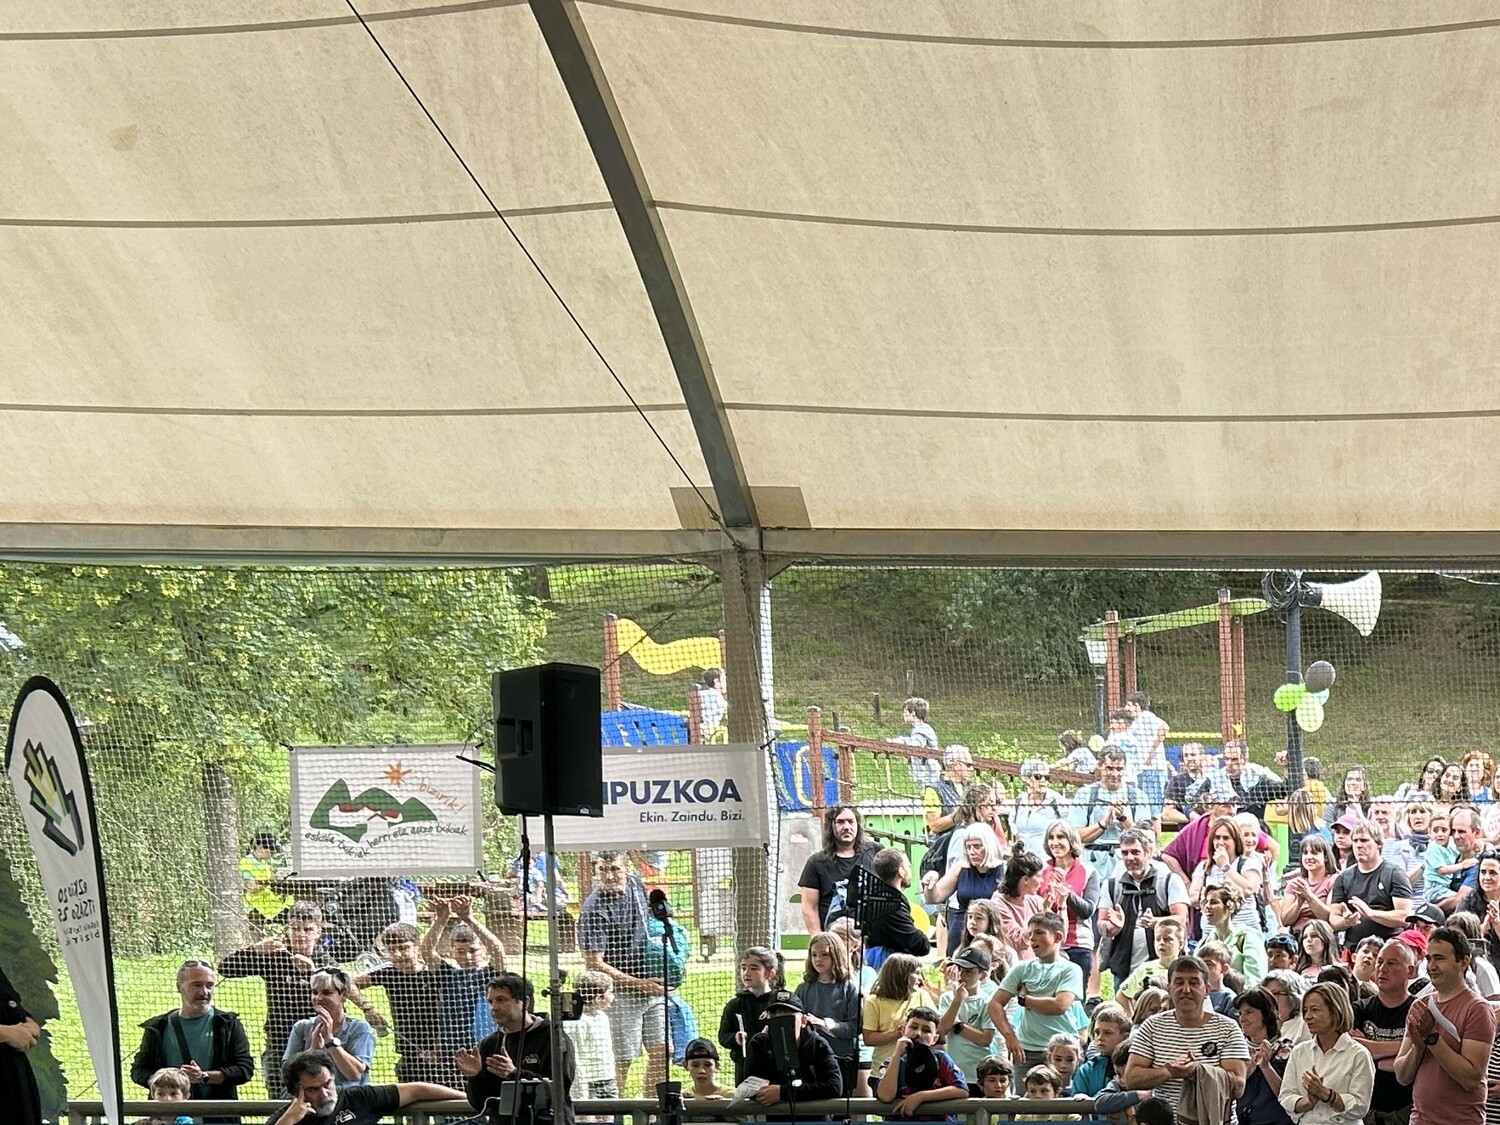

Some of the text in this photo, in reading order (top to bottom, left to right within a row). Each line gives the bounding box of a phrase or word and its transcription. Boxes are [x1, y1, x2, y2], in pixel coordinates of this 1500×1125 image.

[602, 778, 743, 805] IPUZKOA
[639, 809, 745, 823] Ekin. Zaindu. Bizi.
